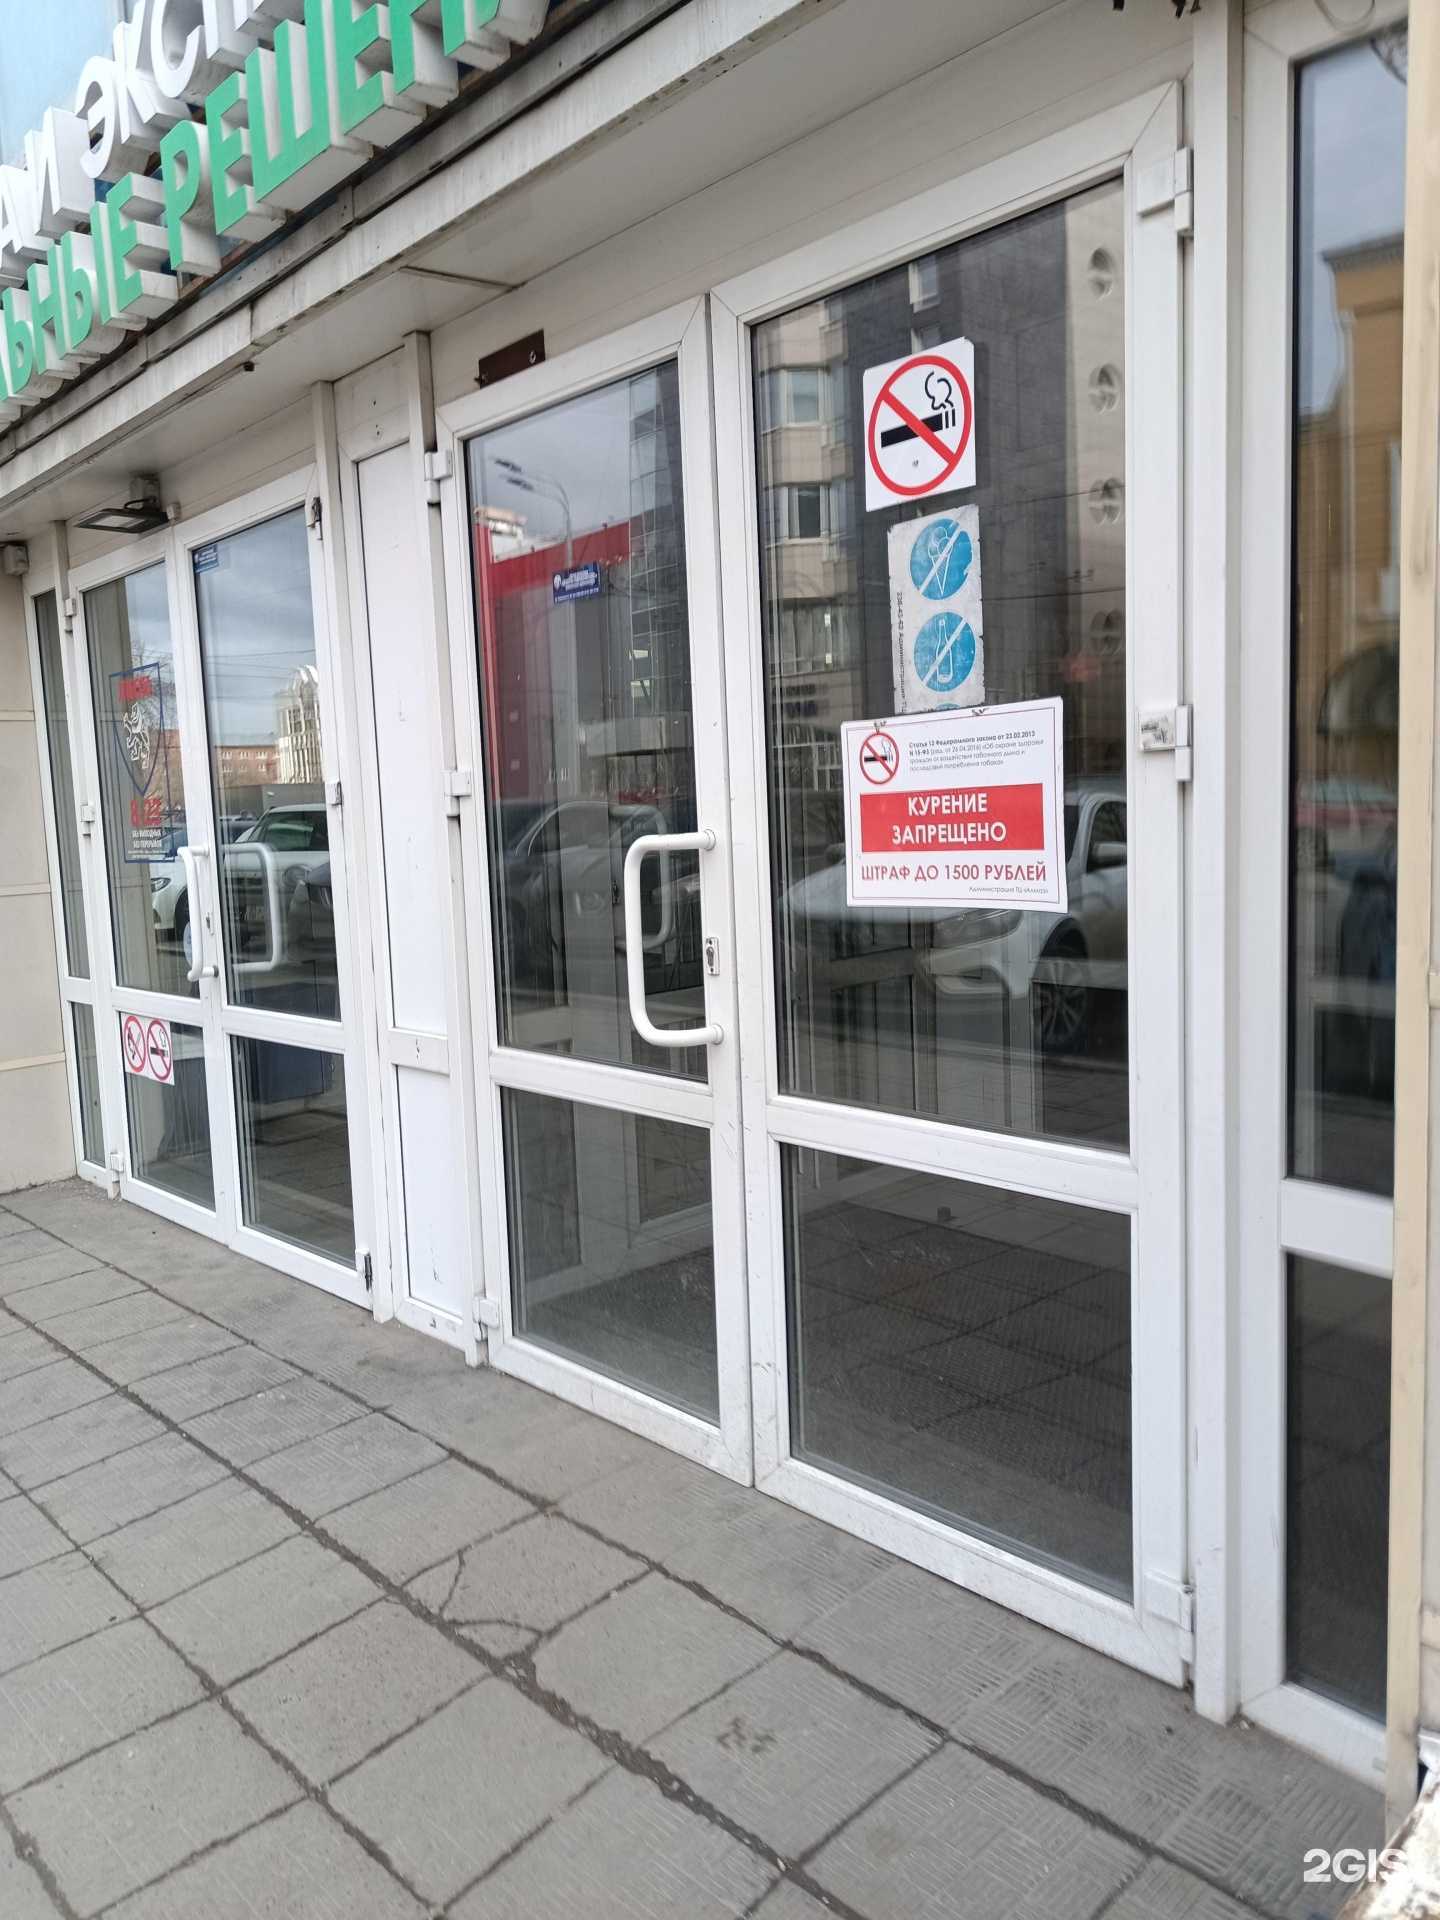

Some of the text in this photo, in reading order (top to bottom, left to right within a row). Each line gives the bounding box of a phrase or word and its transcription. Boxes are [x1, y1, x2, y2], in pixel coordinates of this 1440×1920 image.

[75, 0, 266, 179] ЭКС
[0, 0, 500, 400] ЬНЫЕ РЕШЕН
[936, 737, 975, 747] Федерального
[976, 734, 997, 743] закона
[907, 793, 988, 816] КУРЕНИЕ
[892, 821, 1007, 844] ЗАПРЕЩЕНО
[861, 860, 1047, 881] ШТРАФ ДО 1500 РУБЛЕЙ
